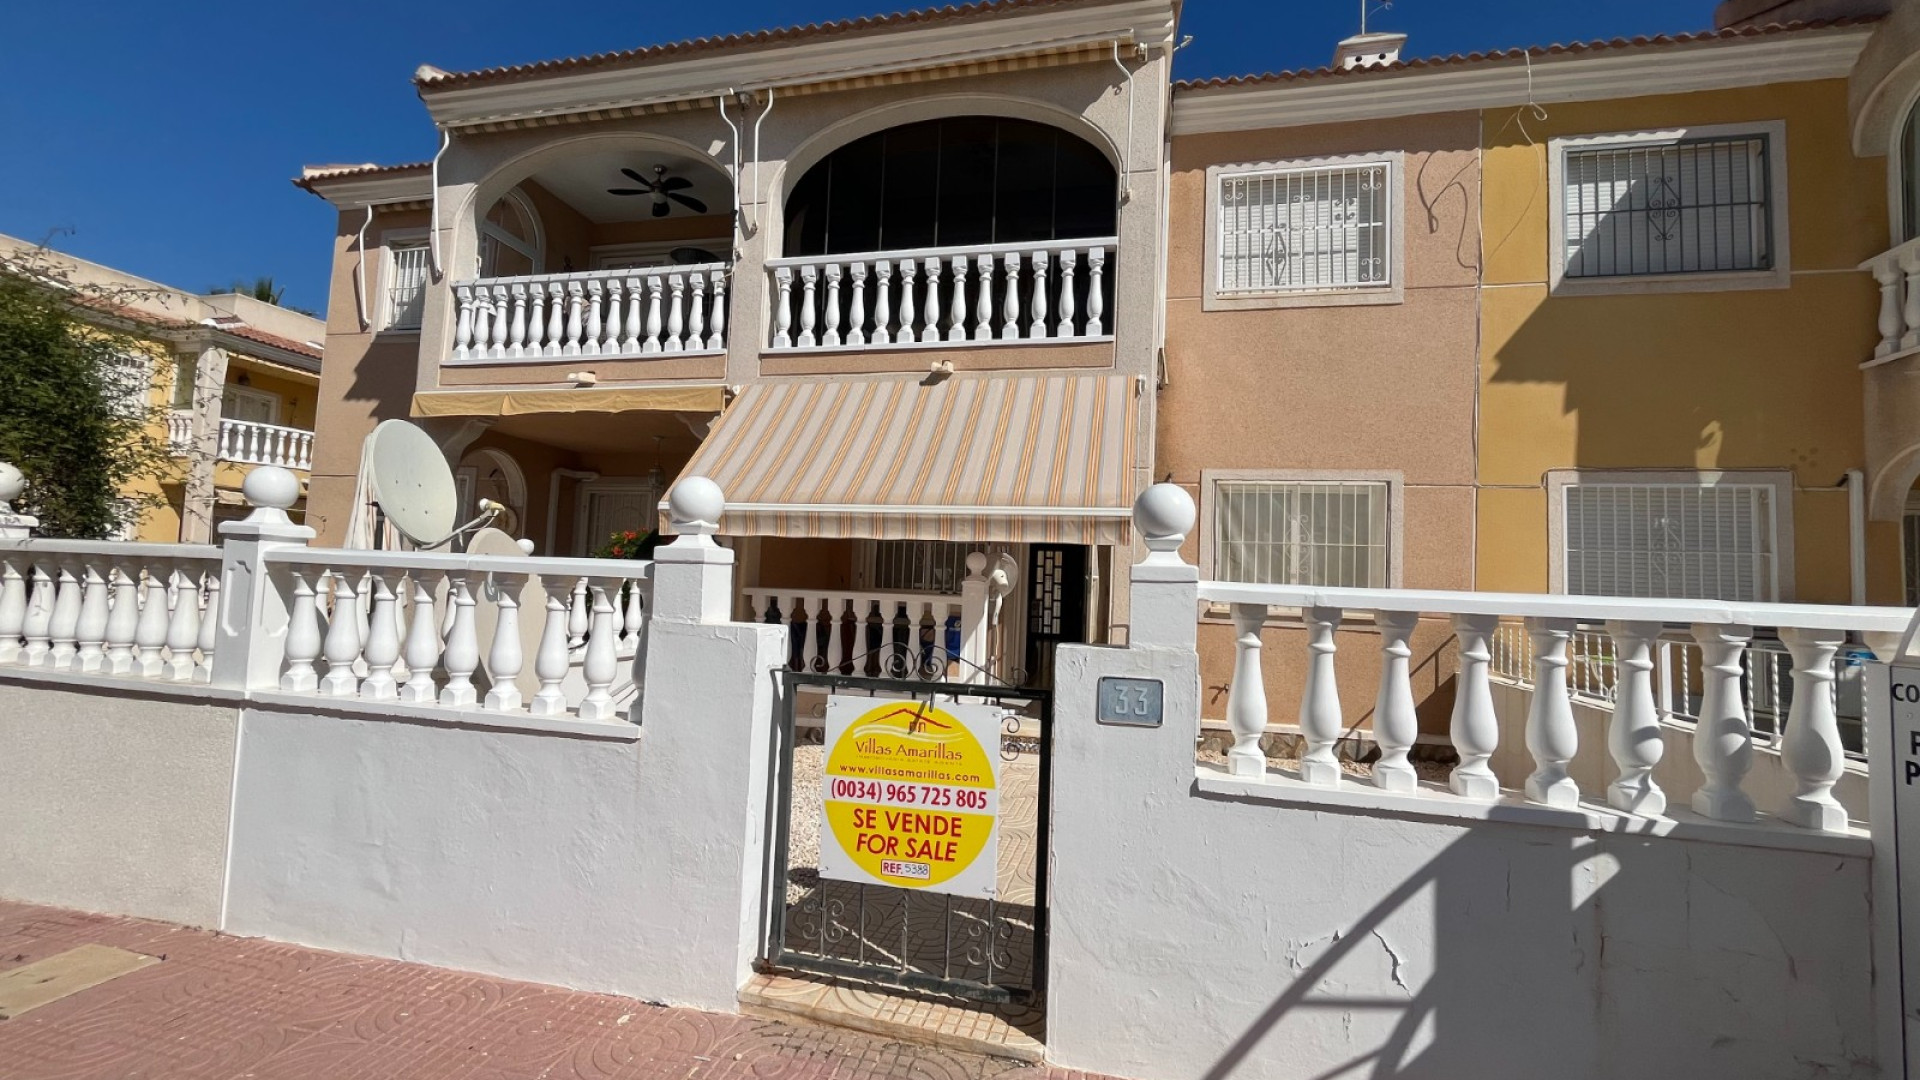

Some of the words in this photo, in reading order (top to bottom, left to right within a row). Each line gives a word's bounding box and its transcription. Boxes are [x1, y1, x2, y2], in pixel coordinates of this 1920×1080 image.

[1114, 685, 1148, 716] 33
[855, 738, 892, 756] Villas
[895, 742, 963, 761] Amarillas
[839, 764, 980, 783] www.villasamarillas.com
[831, 778, 882, 803] (0034)
[886, 784, 917, 803] 965
[920, 786, 951, 806] 725
[956, 789, 988, 810] 805
[852, 808, 877, 829] SE
[885, 811, 962, 838] VENDE
[856, 833, 899, 857] FOR
[905, 837, 958, 862] SALE
